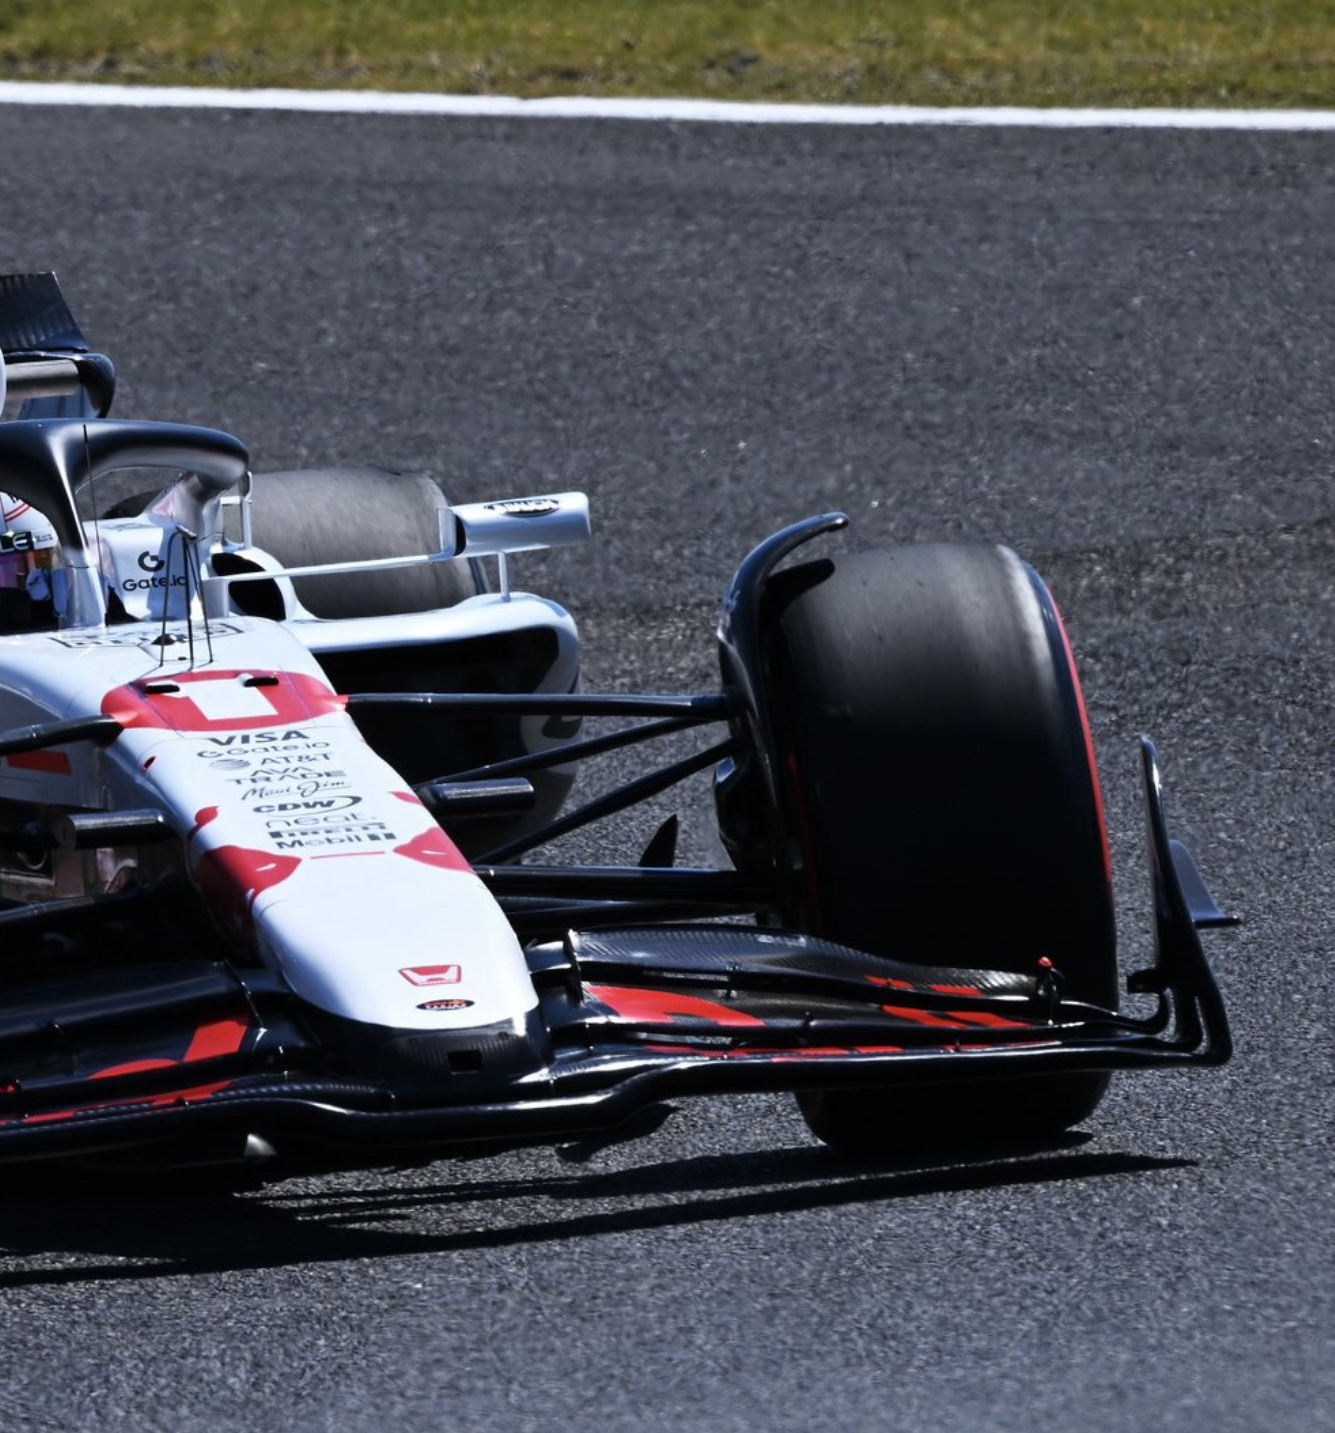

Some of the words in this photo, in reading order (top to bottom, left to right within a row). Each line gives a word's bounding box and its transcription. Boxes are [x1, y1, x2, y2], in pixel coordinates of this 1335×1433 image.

[122, 574, 187, 592] Gate.io
[146, 678, 279, 721] 1
[207, 730, 310, 747] VISA
[227, 742, 330, 755] Gate.io
[261, 753, 334, 766] AT&T
[225, 770, 347, 786] TRADE
[251, 766, 314, 777] AVA
[241, 786, 292, 800] Maui
[296, 781, 345, 798] Jim
[252, 800, 336, 813] CDW
[275, 834, 362, 849] Mobil
